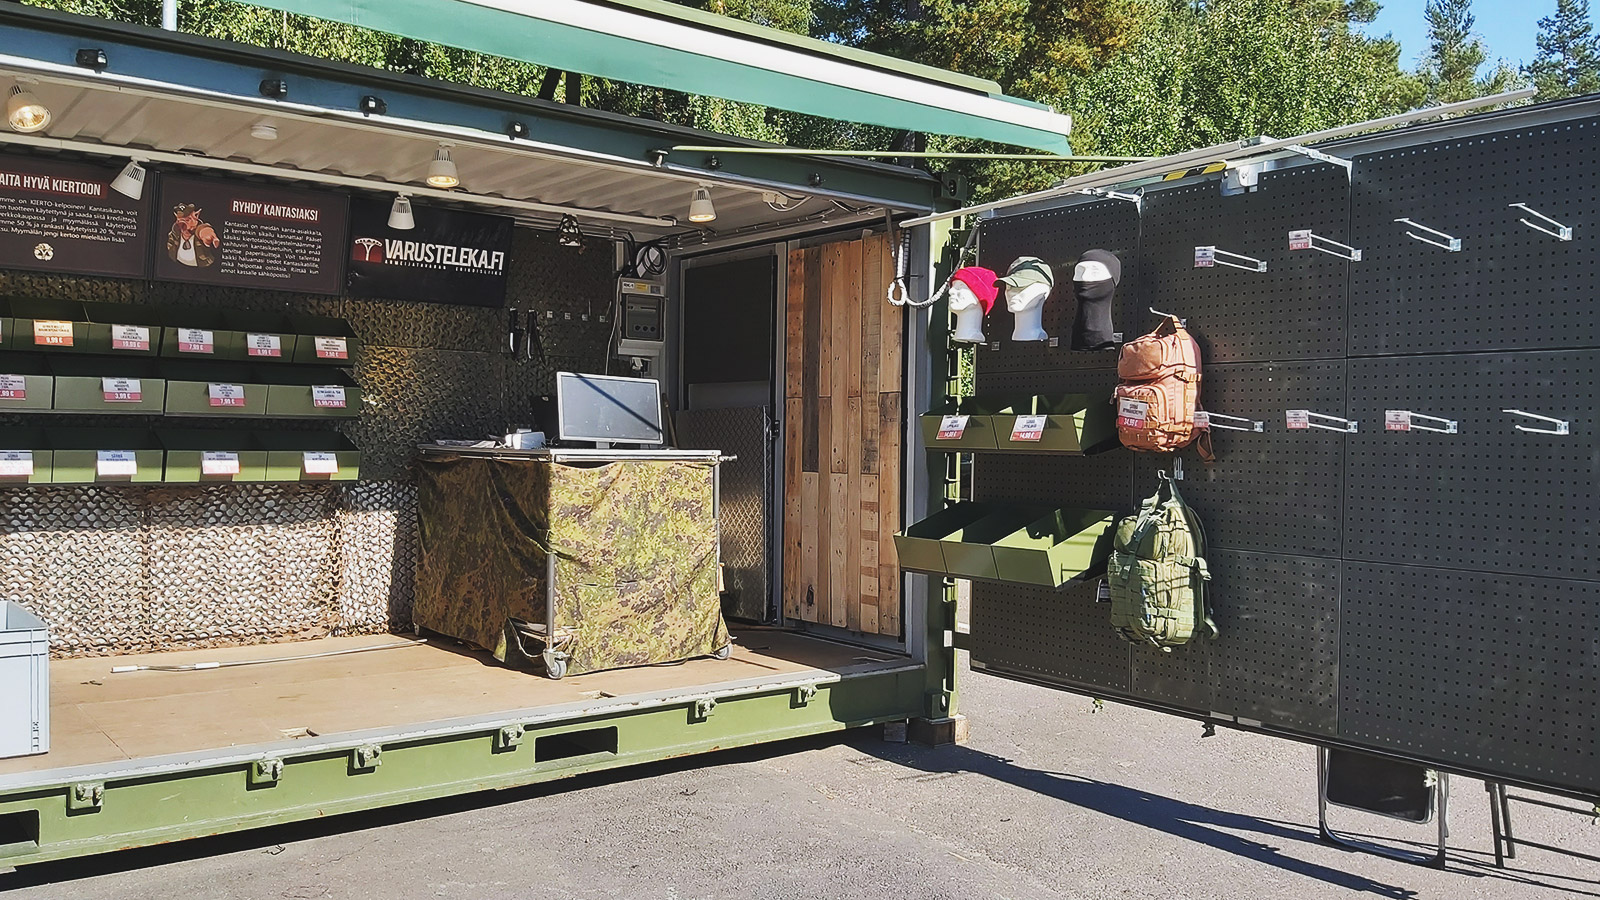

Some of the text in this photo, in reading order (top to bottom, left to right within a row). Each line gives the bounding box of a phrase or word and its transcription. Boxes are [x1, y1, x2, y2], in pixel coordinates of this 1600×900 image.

[23, 176, 50, 190] HYVÄ
[52, 179, 101, 196] KIERTOON
[232, 200, 318, 221] RYHDY KANTASIAKSI
[385, 238, 504, 270] VARUSTELEKA.FI
